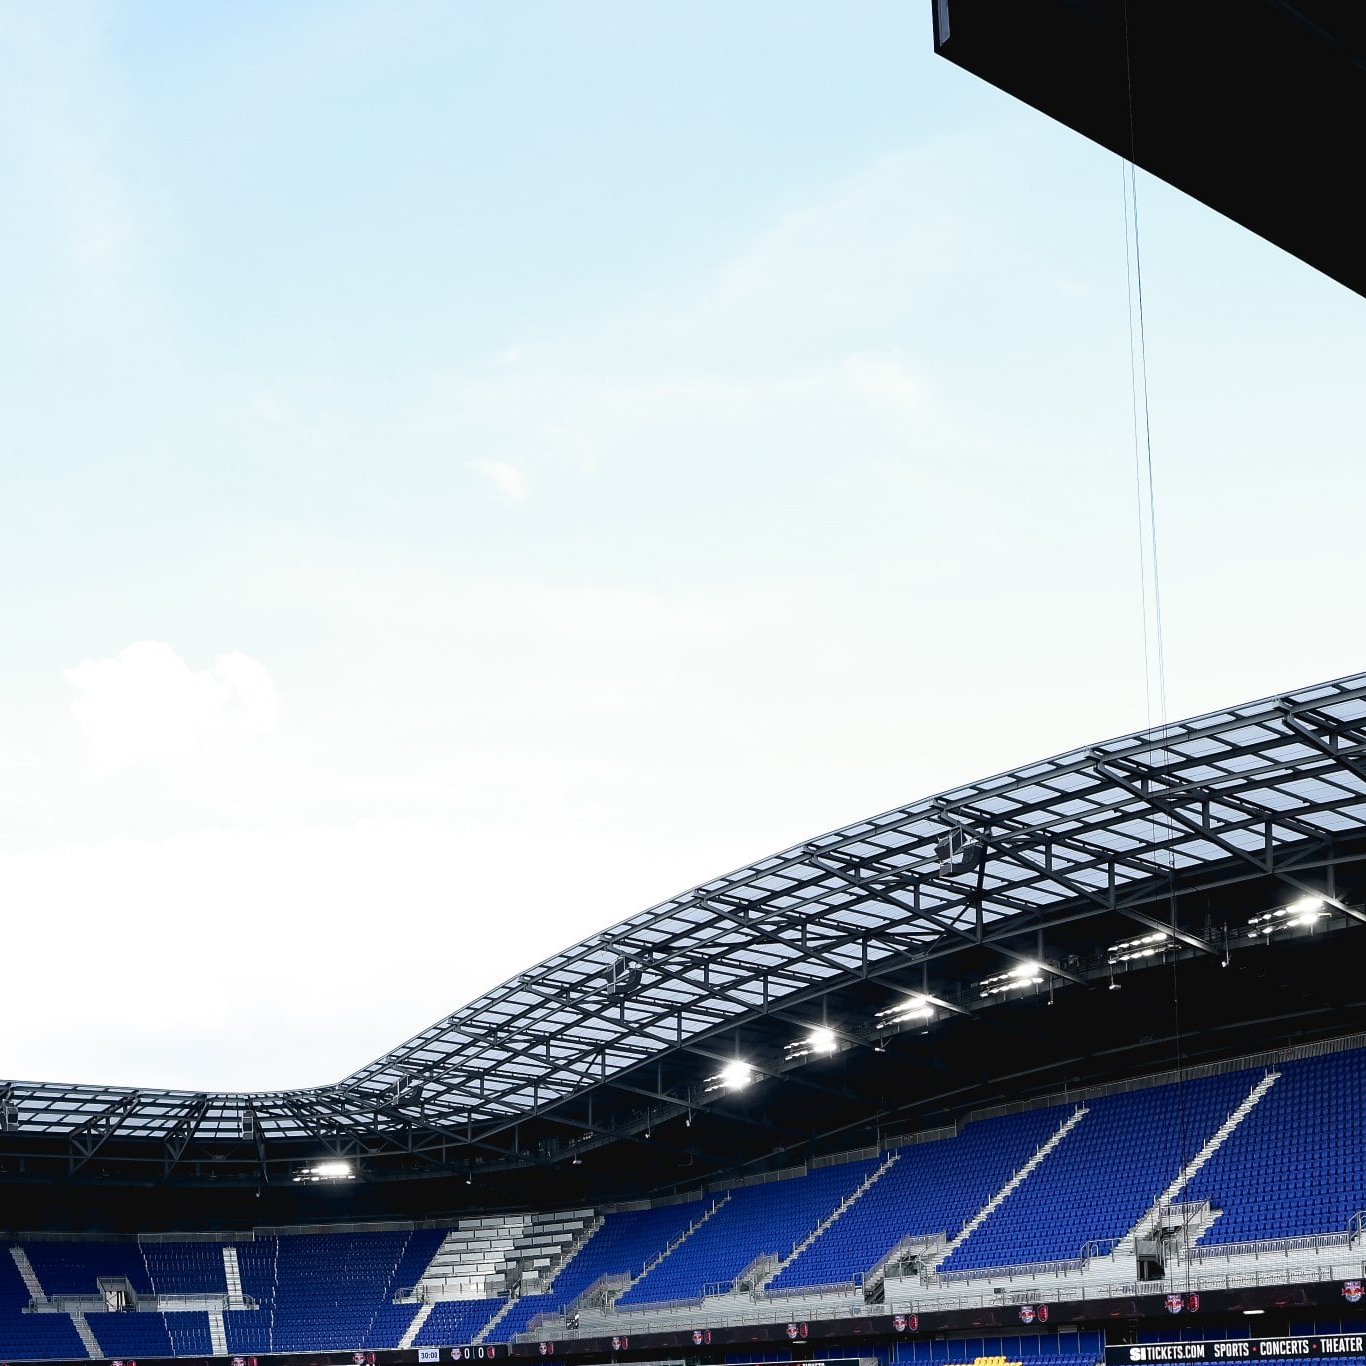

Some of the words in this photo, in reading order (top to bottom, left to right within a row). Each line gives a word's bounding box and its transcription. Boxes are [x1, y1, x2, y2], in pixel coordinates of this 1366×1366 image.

[479, 1347, 484, 1358] 0
[1214, 1342, 1249, 1358] SPORTS
[1260, 1340, 1309, 1356] CONCERTS
[1320, 1337, 1363, 1353] THEATER
[465, 1348, 470, 1359] 0
